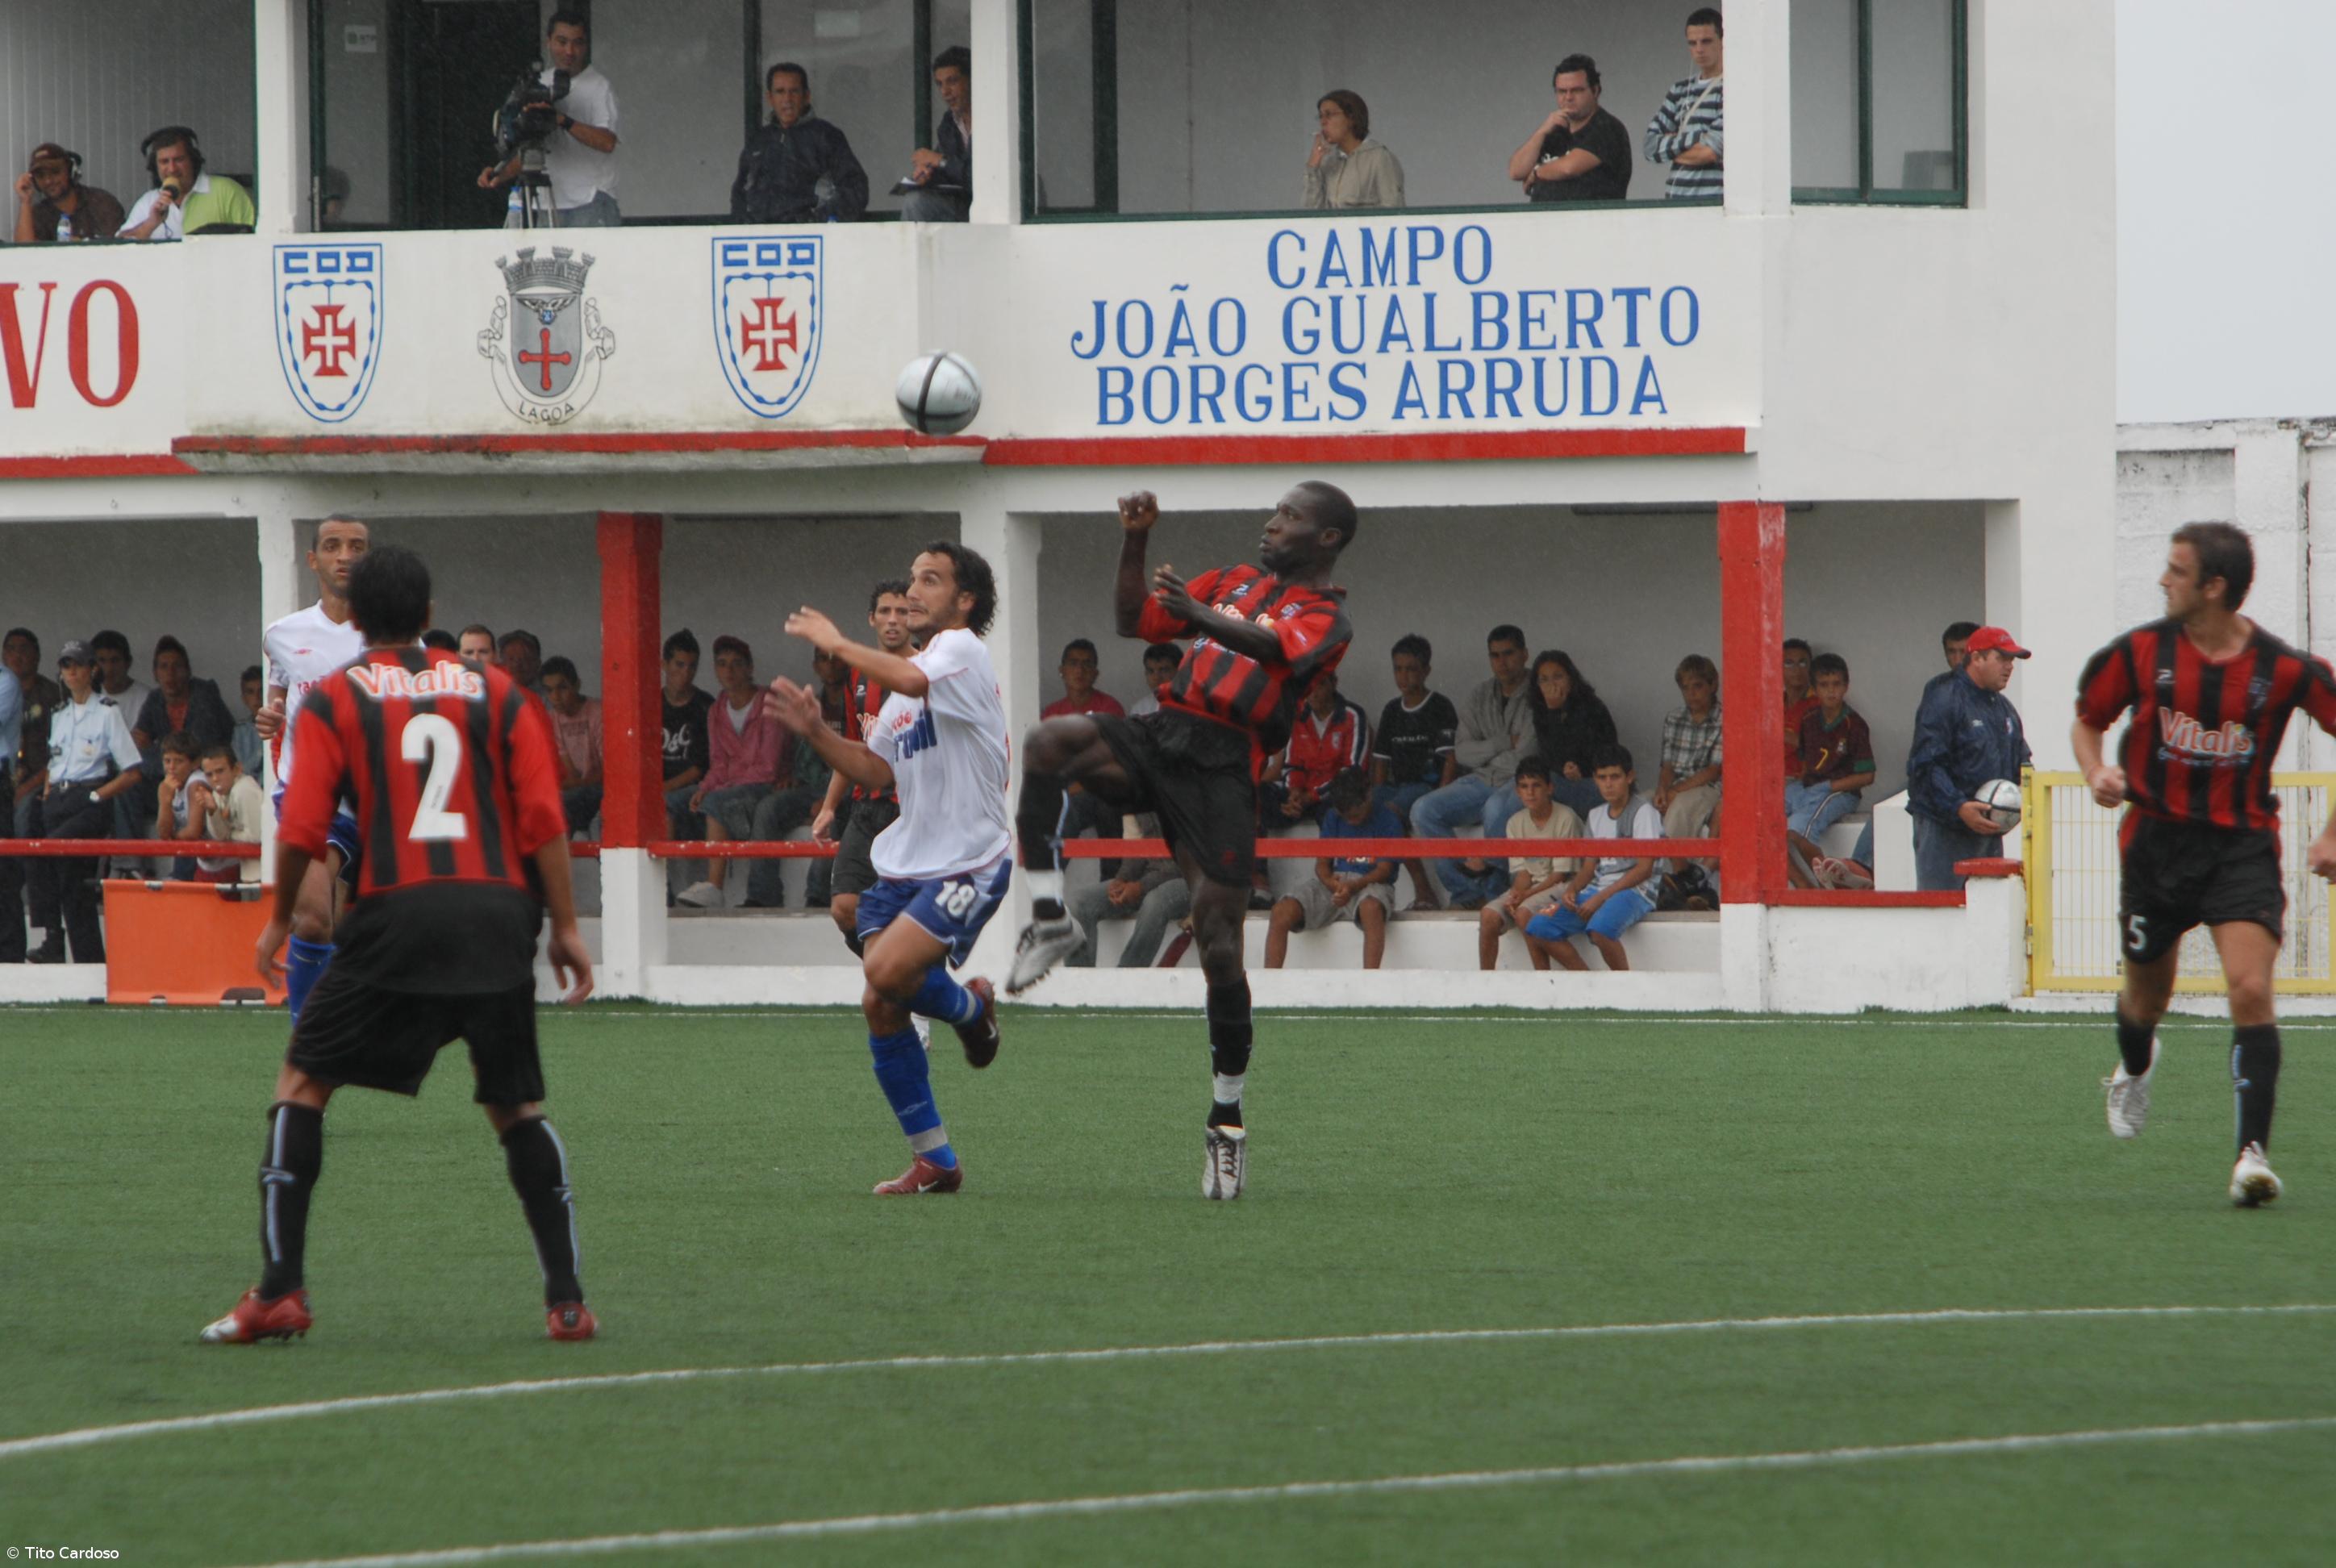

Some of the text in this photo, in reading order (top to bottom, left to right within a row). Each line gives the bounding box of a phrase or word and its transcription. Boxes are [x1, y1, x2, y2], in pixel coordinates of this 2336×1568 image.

[284, 252, 373, 273] COD
[723, 243, 815, 266] COD
[1268, 225, 1492, 289] CAMPO
[1071, 284, 1699, 360] JOÃO GUALBERTO
[1097, 355, 1666, 425] BORGES ARRUDA
[519, 400, 574, 421] LAGOA
[346, 660, 485, 700] Vitalis
[401, 713, 468, 840] 2
[1814, 747, 1829, 770] 7
[935, 880, 976, 917] 18
[2129, 915, 2147, 950] 5
